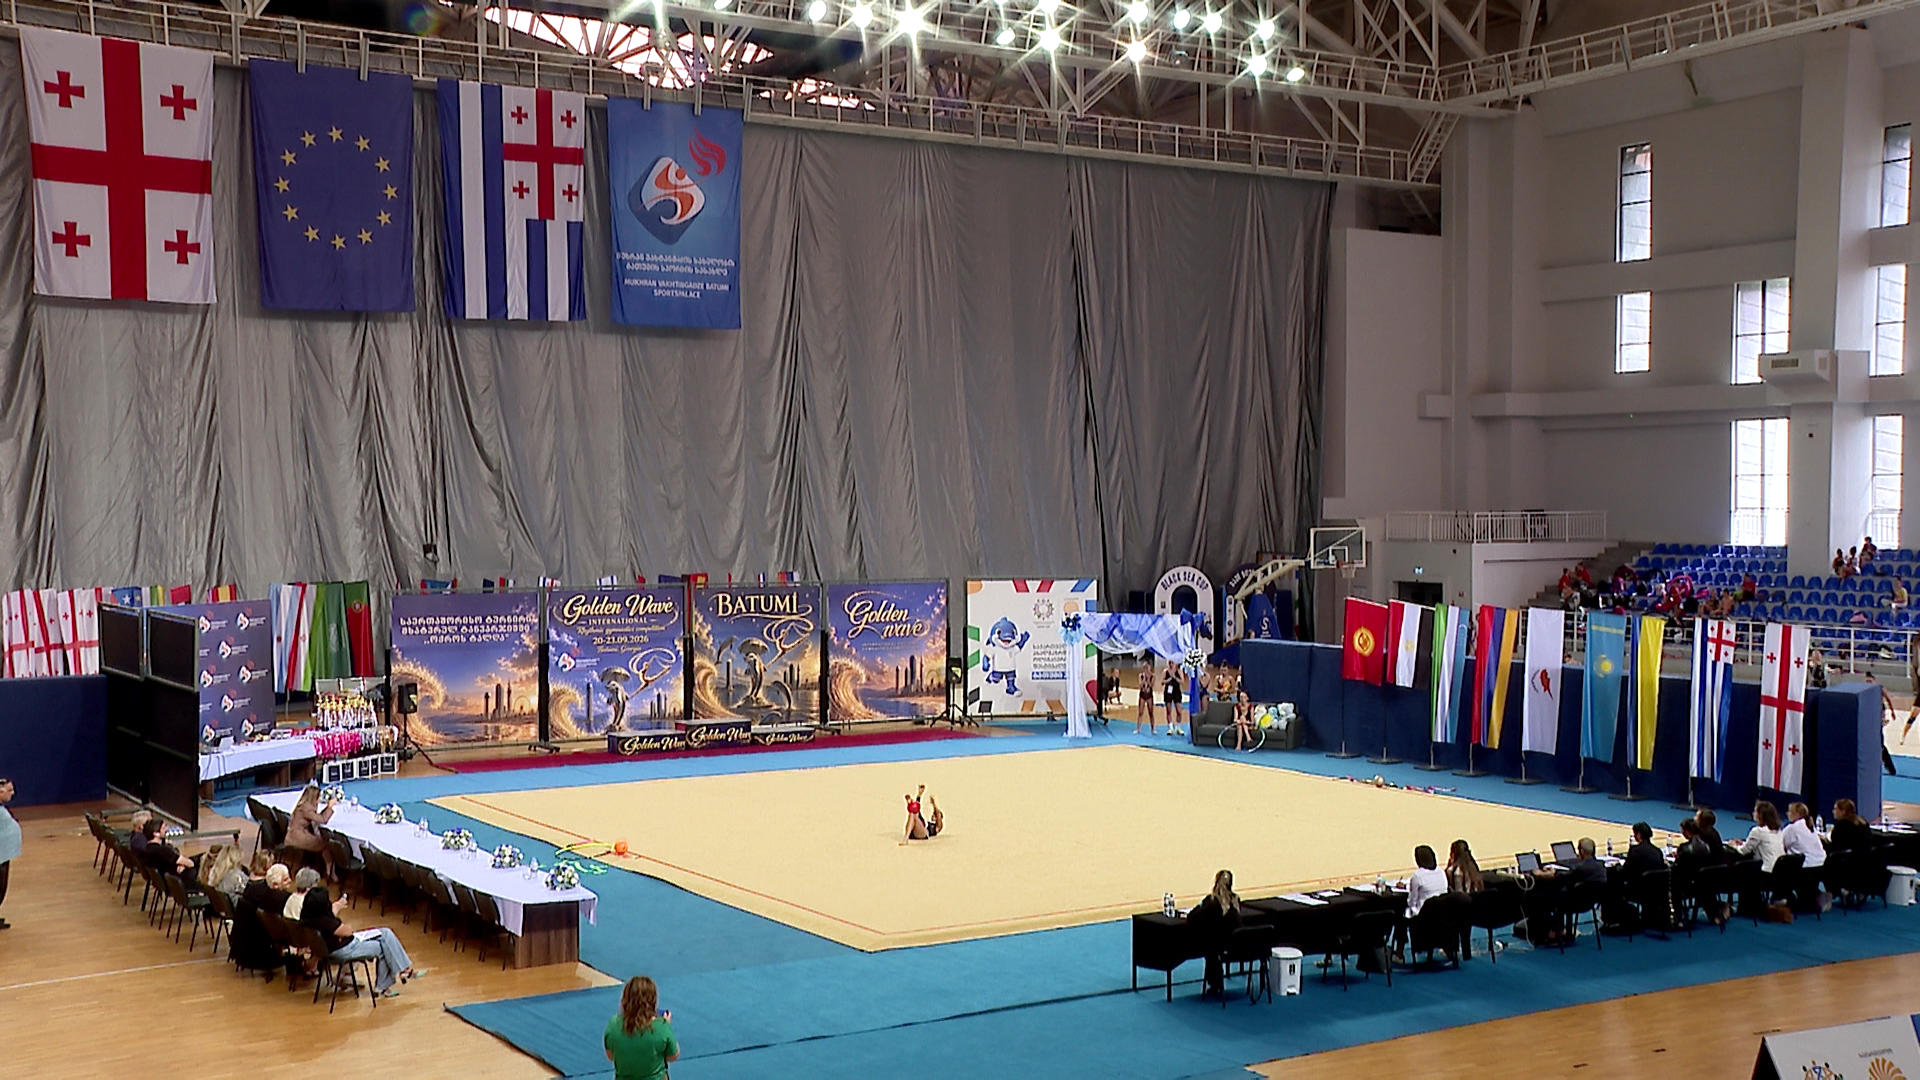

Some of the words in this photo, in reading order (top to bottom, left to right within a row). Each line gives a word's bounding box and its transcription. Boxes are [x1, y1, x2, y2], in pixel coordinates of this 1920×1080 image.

[1161, 572, 1181, 590] BLACK
[1184, 571, 1196, 582] SEA
[1196, 576, 1209, 590] CUP
[563, 594, 623, 626] Golden
[625, 593, 674, 617] Wave
[717, 591, 798, 616] BATUMI
[848, 600, 909, 626] Golden
[883, 617, 925, 638] wave
[727, 727, 751, 742] Wav
